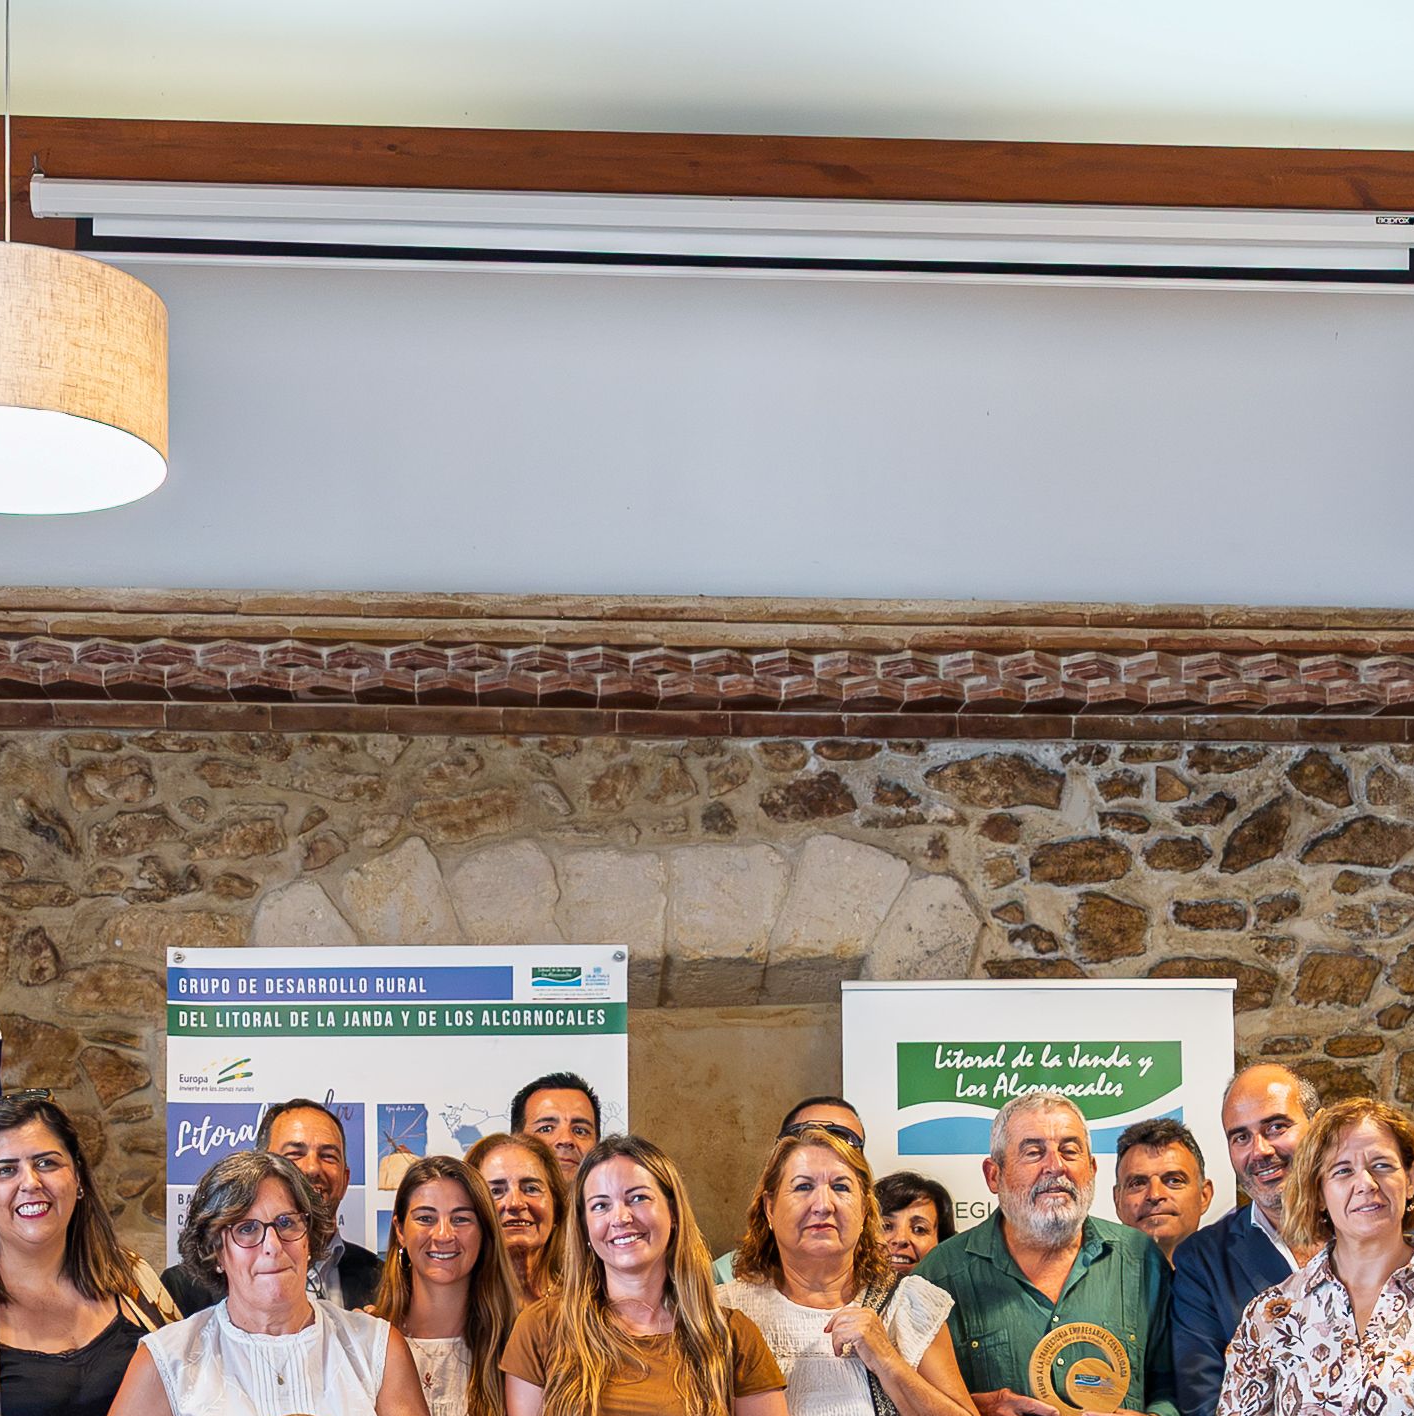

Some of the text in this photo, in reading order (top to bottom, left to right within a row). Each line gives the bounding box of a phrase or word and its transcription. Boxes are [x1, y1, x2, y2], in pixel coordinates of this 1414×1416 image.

[178, 976, 427, 995] GRUPO DE DESARROLLO RURAL
[178, 1008, 606, 1028] DEL LITORAL DE LA JANDA Y DE LOS ALCORNOCALES
[934, 1043, 1154, 1077] Litoral de la Janda y
[179, 1073, 209, 1085] Europa
[955, 1072, 987, 1098] Los
[175, 1102, 269, 1158] Litoral
[1068, 1326, 1109, 1343] EMPRESARIAL
